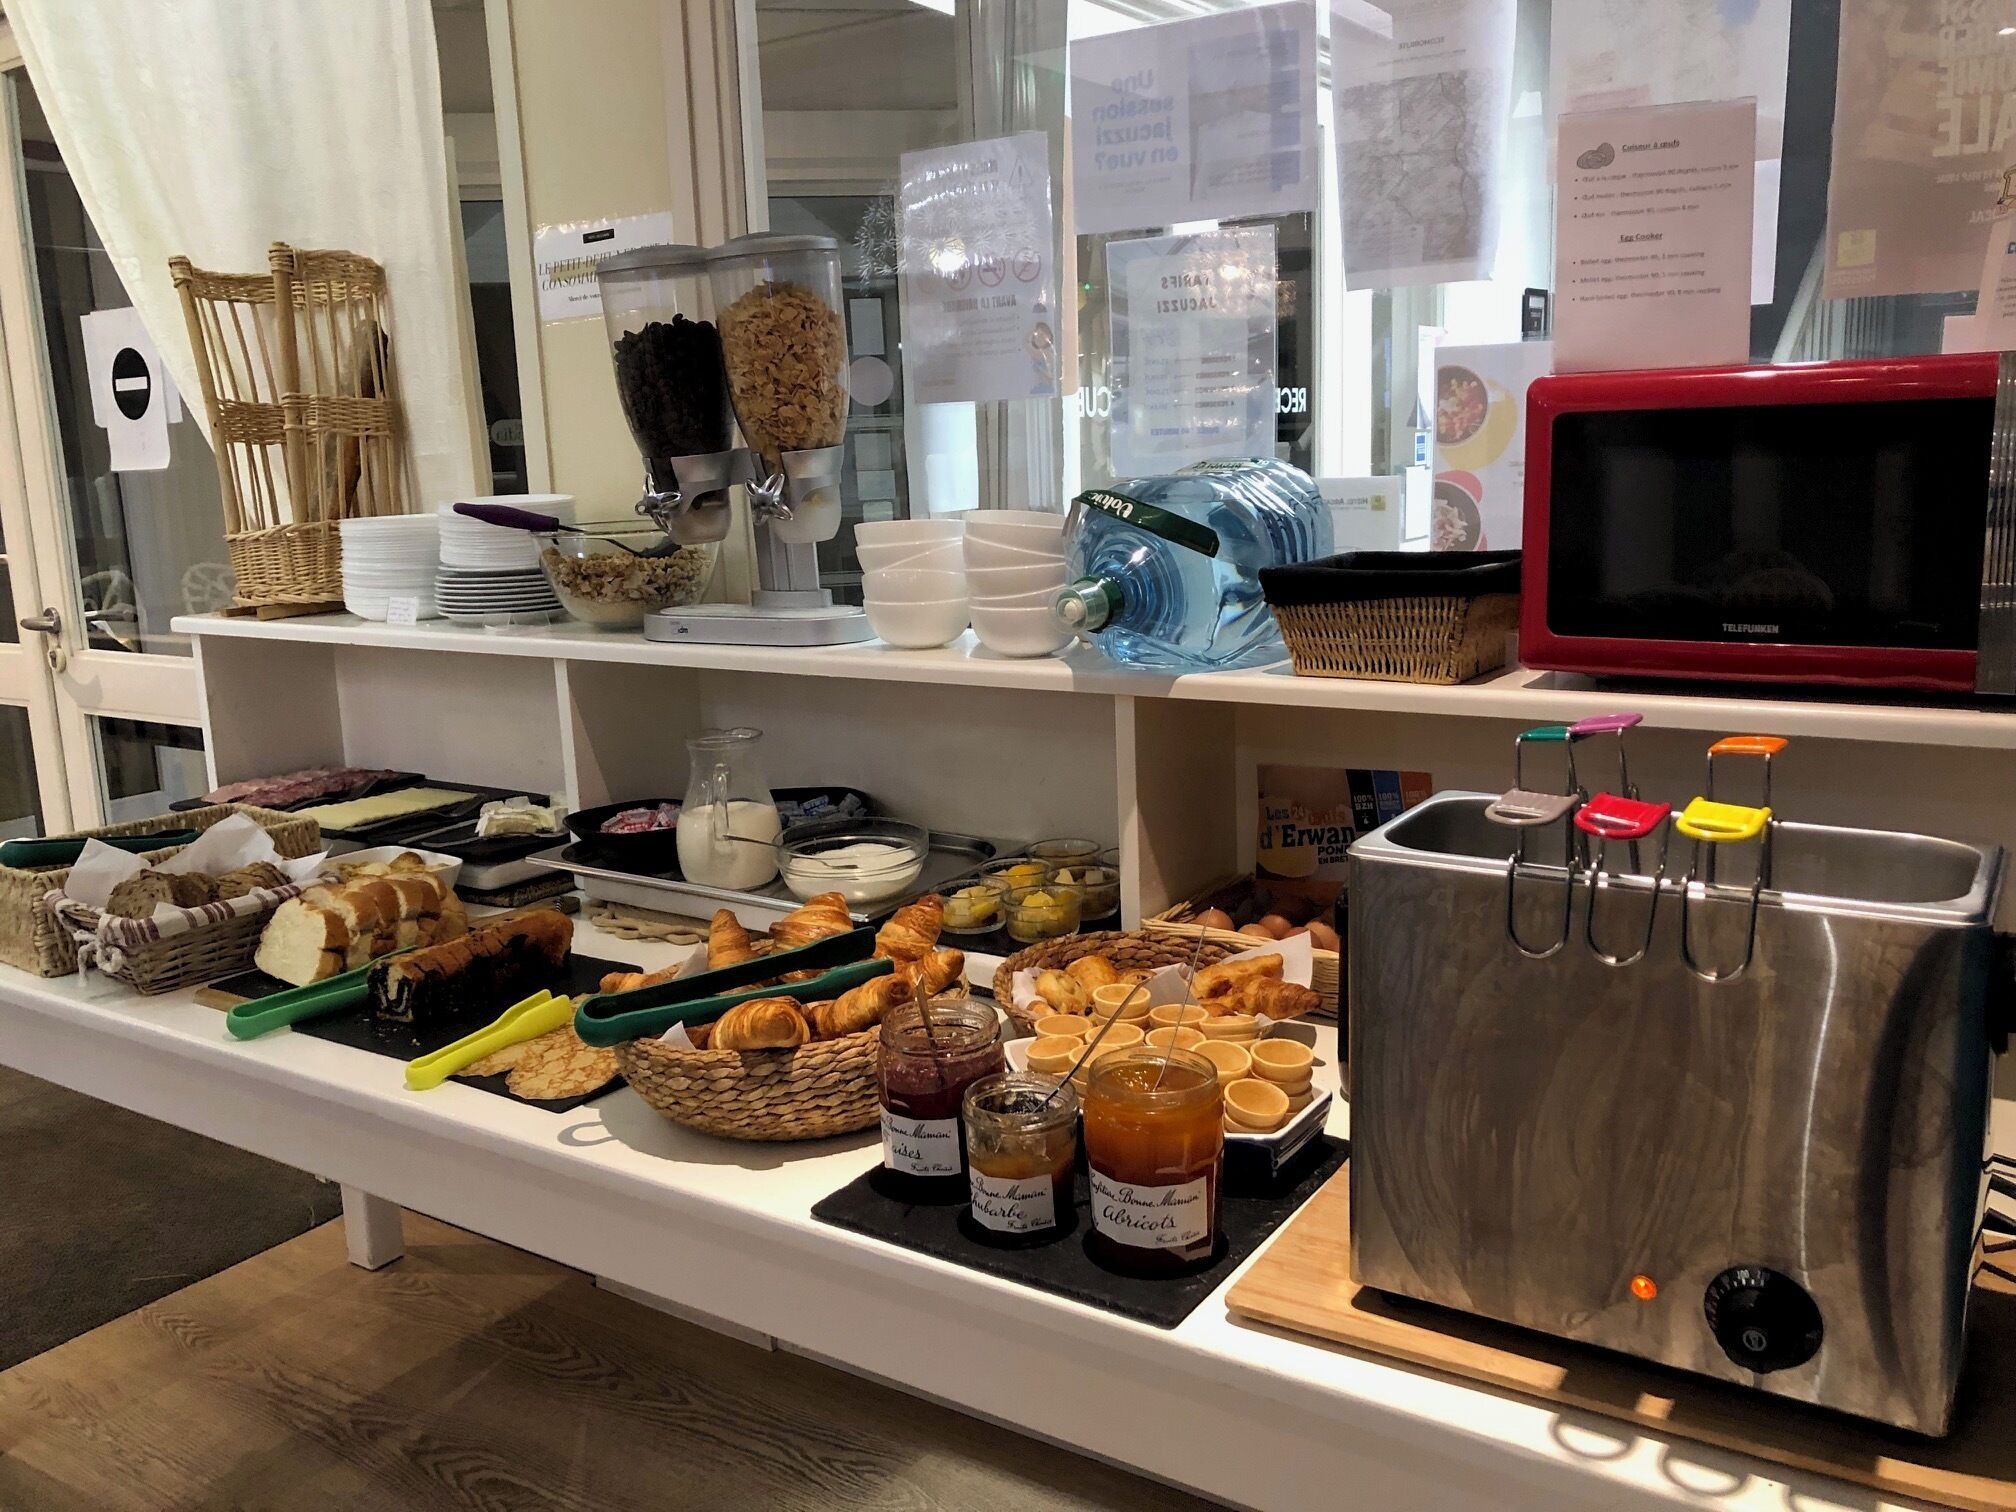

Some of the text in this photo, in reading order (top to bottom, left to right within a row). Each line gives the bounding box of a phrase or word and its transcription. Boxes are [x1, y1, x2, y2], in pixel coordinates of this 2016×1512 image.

[1620, 232, 1663, 243] Egg Cooker
[1088, 492, 1134, 519] Volvic
[1722, 623, 1780, 634] TELEFUNKEN
[1265, 806, 1290, 820] Les
[910, 1123, 952, 1139] Maman
[974, 1176, 1047, 1201] Bonne Maman
[1119, 1187, 1157, 1208] Bonne
[1157, 1188, 1200, 1207] Maman
[971, 1191, 1028, 1220] hubarbe
[1102, 1205, 1178, 1231] Abricots
